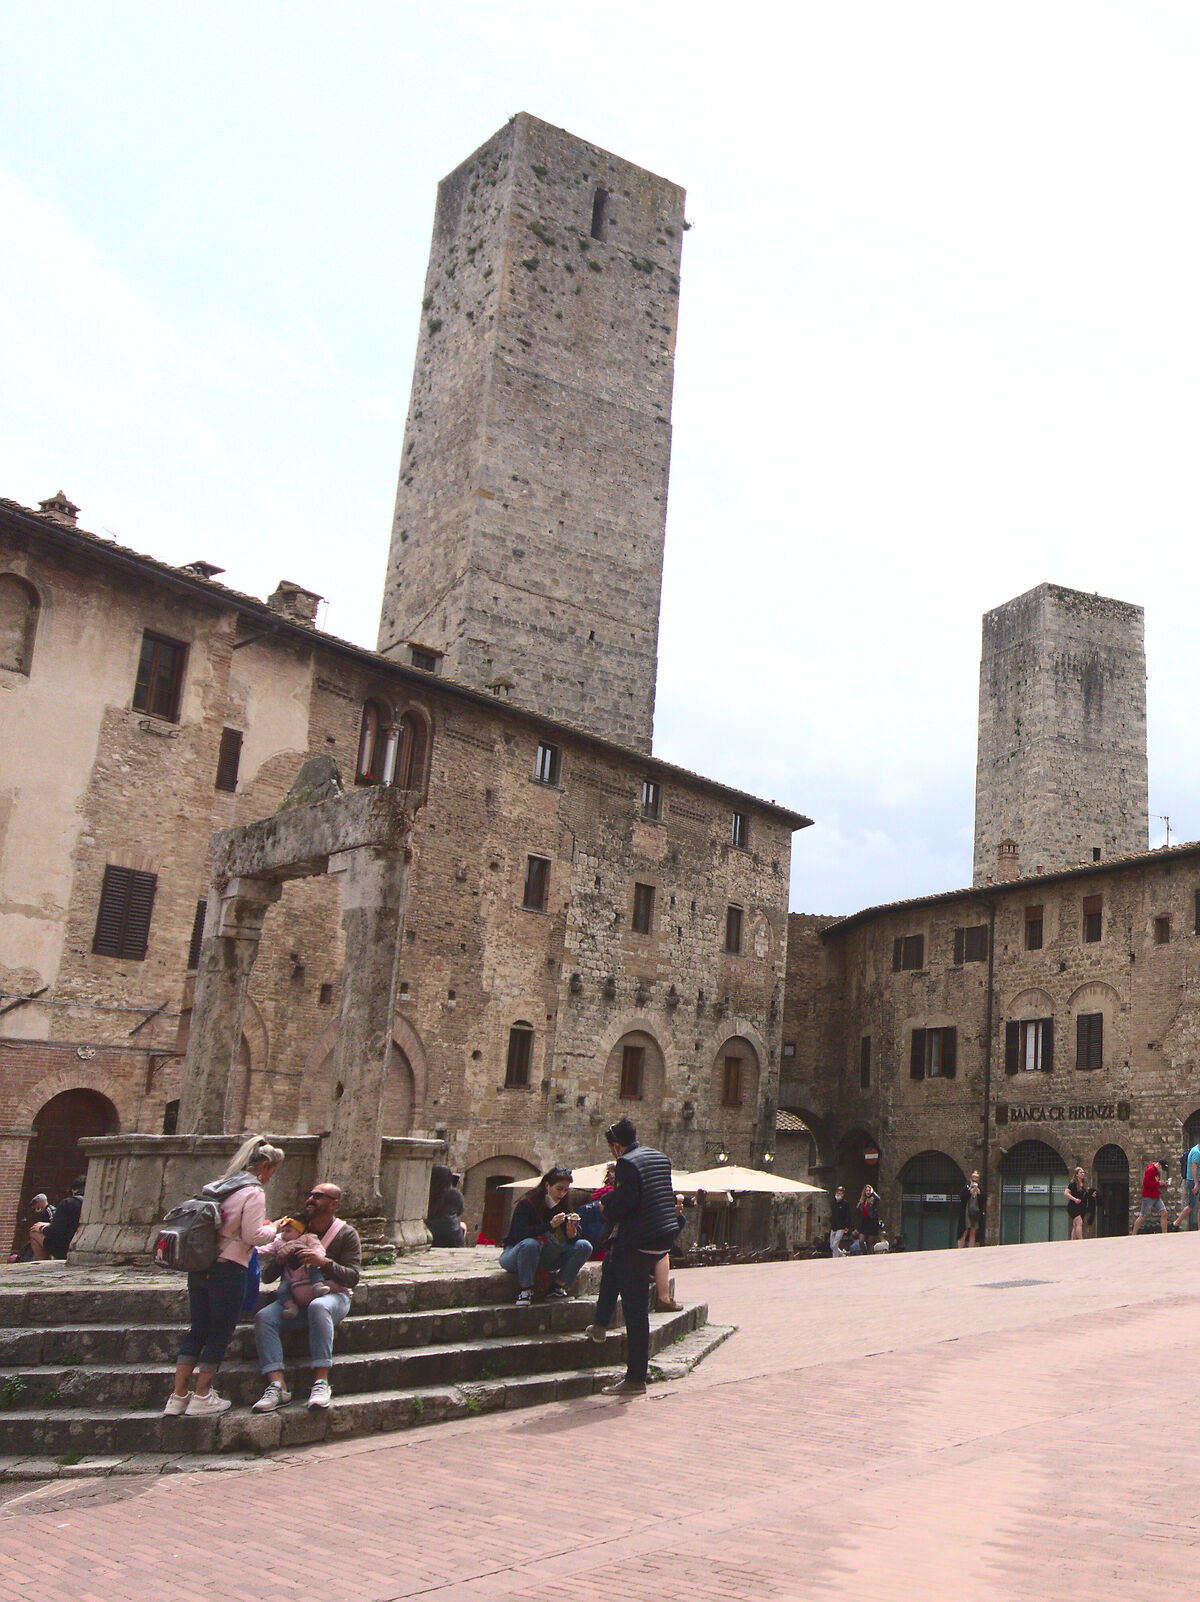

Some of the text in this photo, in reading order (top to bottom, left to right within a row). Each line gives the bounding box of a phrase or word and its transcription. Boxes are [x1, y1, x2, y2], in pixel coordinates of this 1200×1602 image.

[1011, 1104, 1115, 1121] BANCA CR FIRENZE
